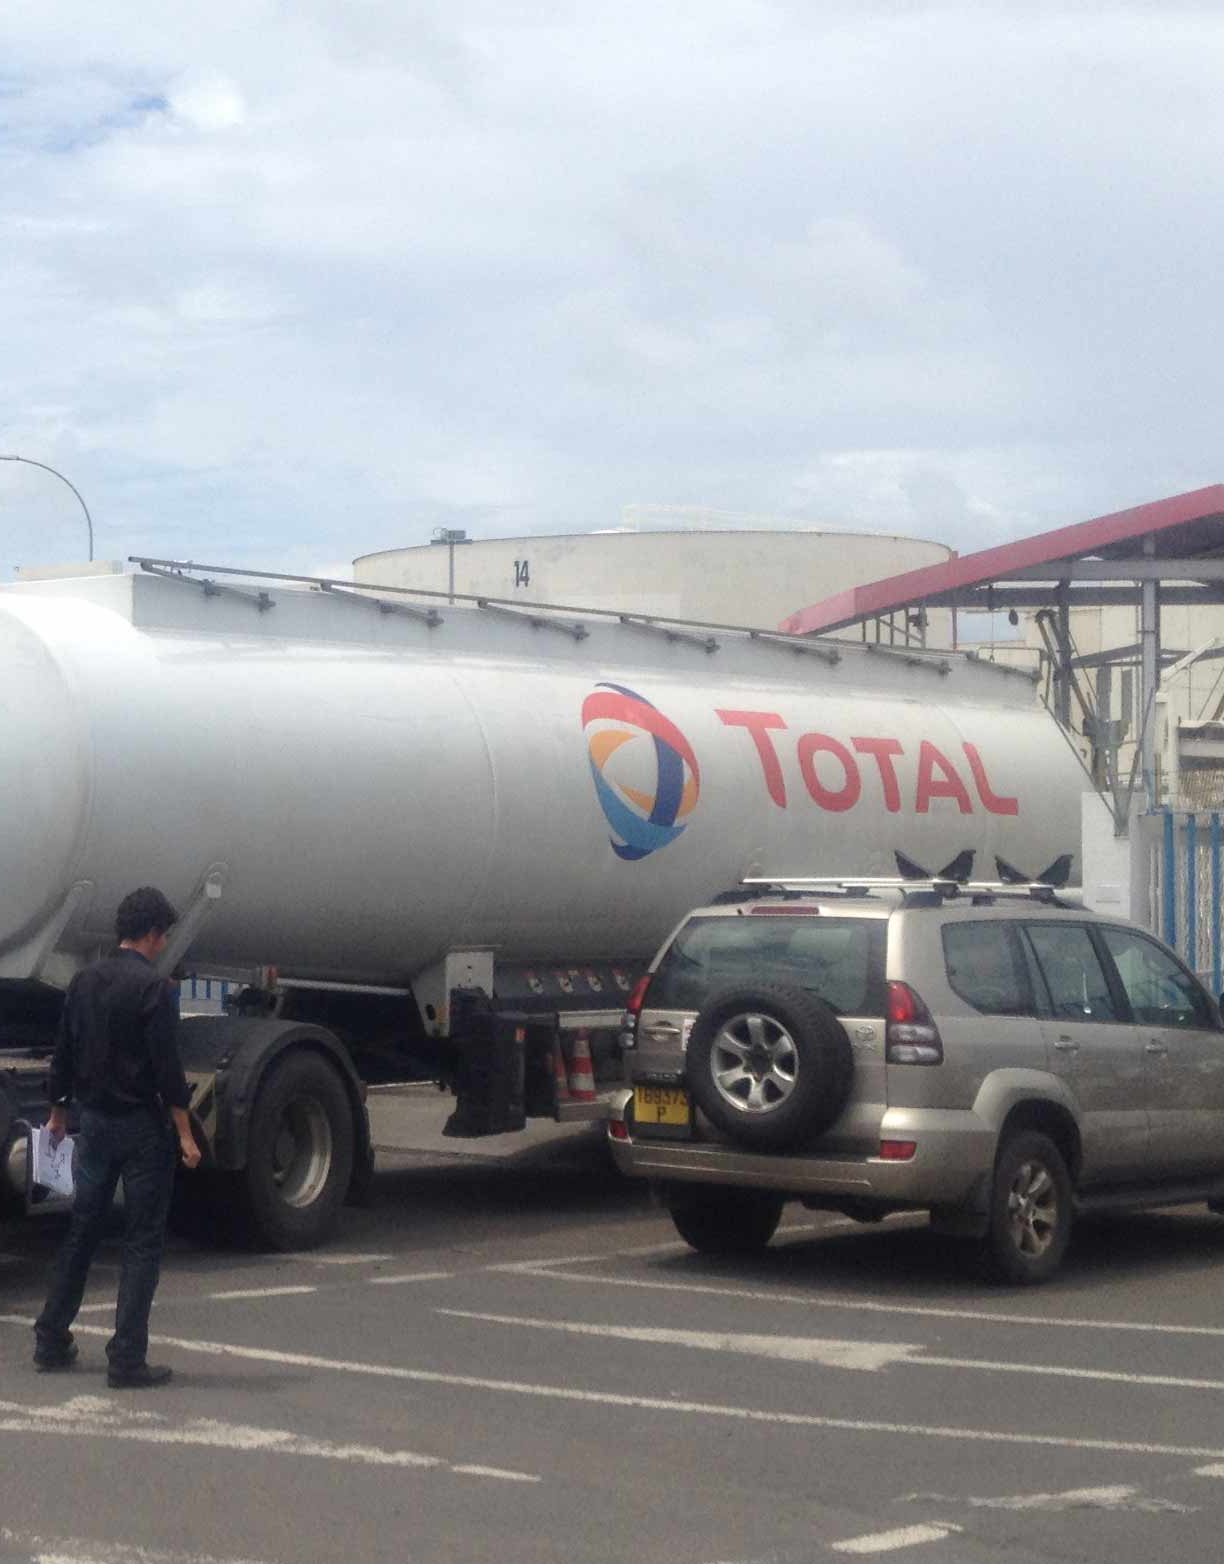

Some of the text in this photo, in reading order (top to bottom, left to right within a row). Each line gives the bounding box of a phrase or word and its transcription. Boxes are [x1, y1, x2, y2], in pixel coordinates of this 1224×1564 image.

[514, 560, 530, 587] 14
[714, 709, 1019, 816] TOTAL
[657, 1106, 666, 1122] P
